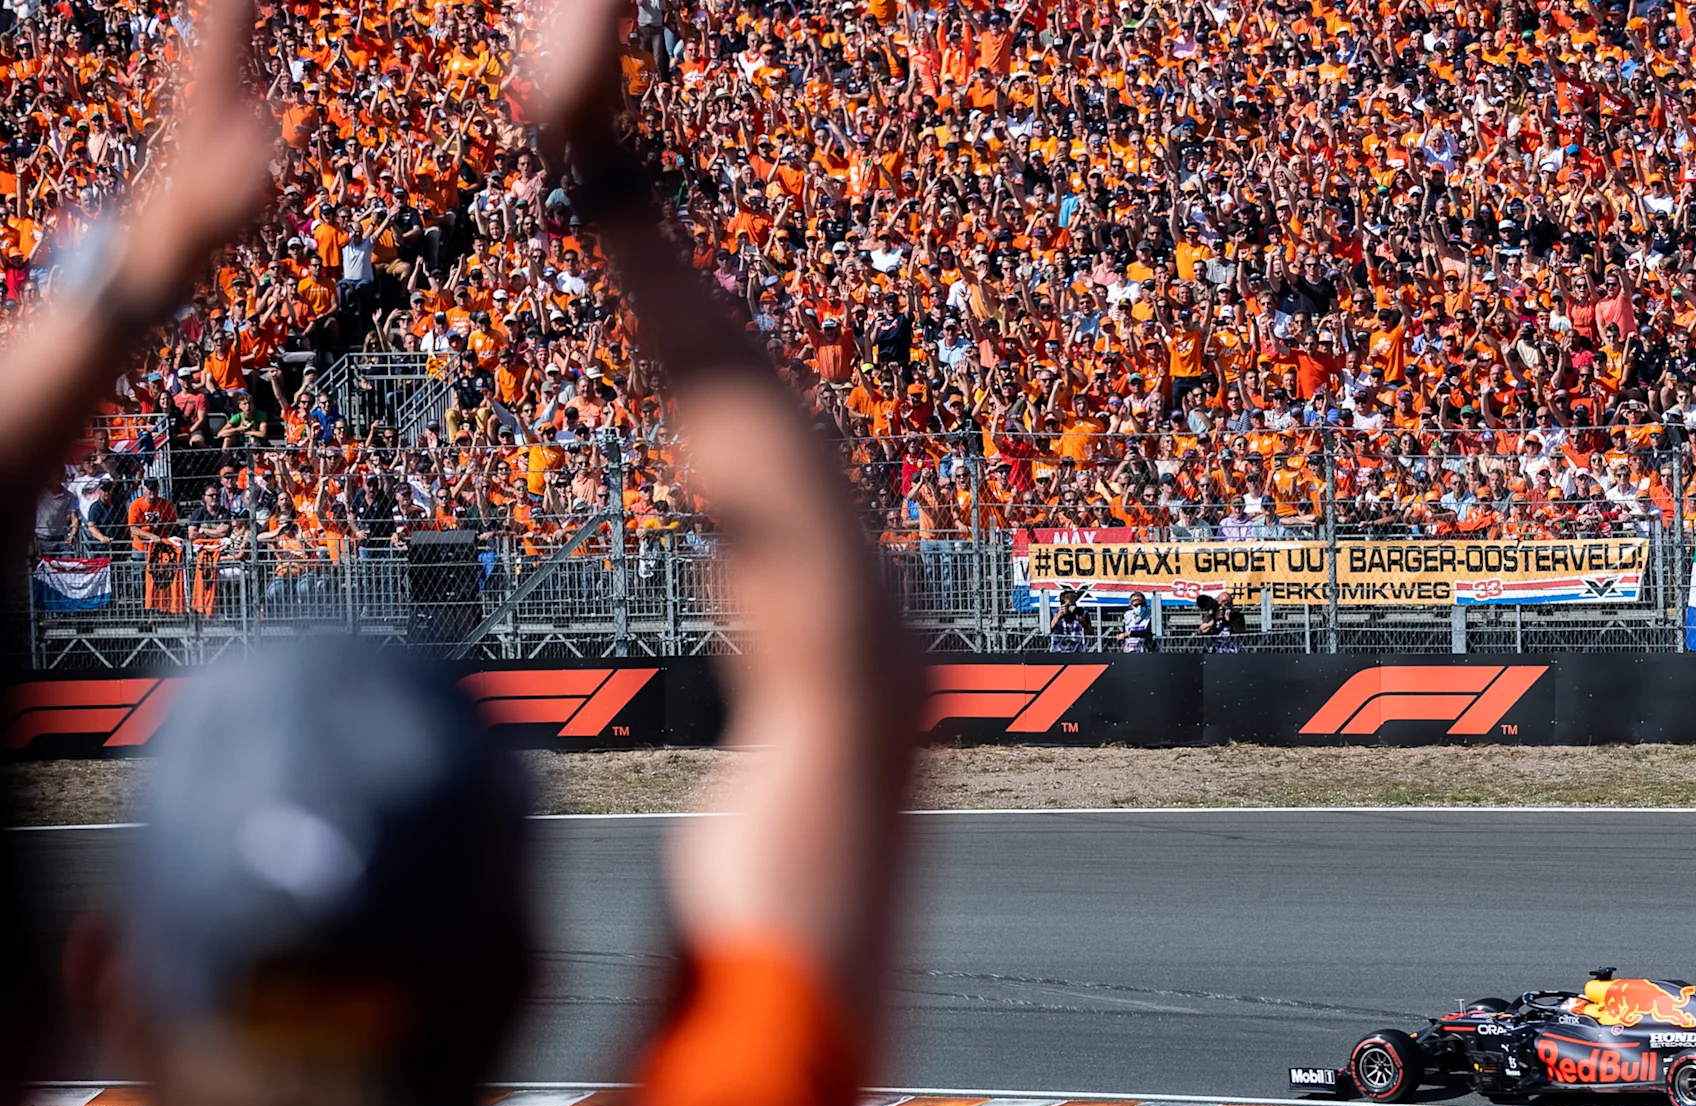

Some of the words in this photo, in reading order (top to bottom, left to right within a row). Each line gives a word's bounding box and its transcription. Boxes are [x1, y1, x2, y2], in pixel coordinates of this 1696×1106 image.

[1035, 548, 1095, 576] #GO
[1103, 547, 1180, 576] MAX!
[1194, 549, 1279, 573] GROET
[1350, 543, 1644, 573] BARGER-OOSTERVELD!
[1173, 581, 1201, 600] 33
[1475, 580, 1502, 599] 33
[611, 727, 630, 737] TM
[1061, 723, 1079, 733] TM
[1500, 725, 1518, 735] TM
[1291, 1068, 1325, 1084] Mobil
